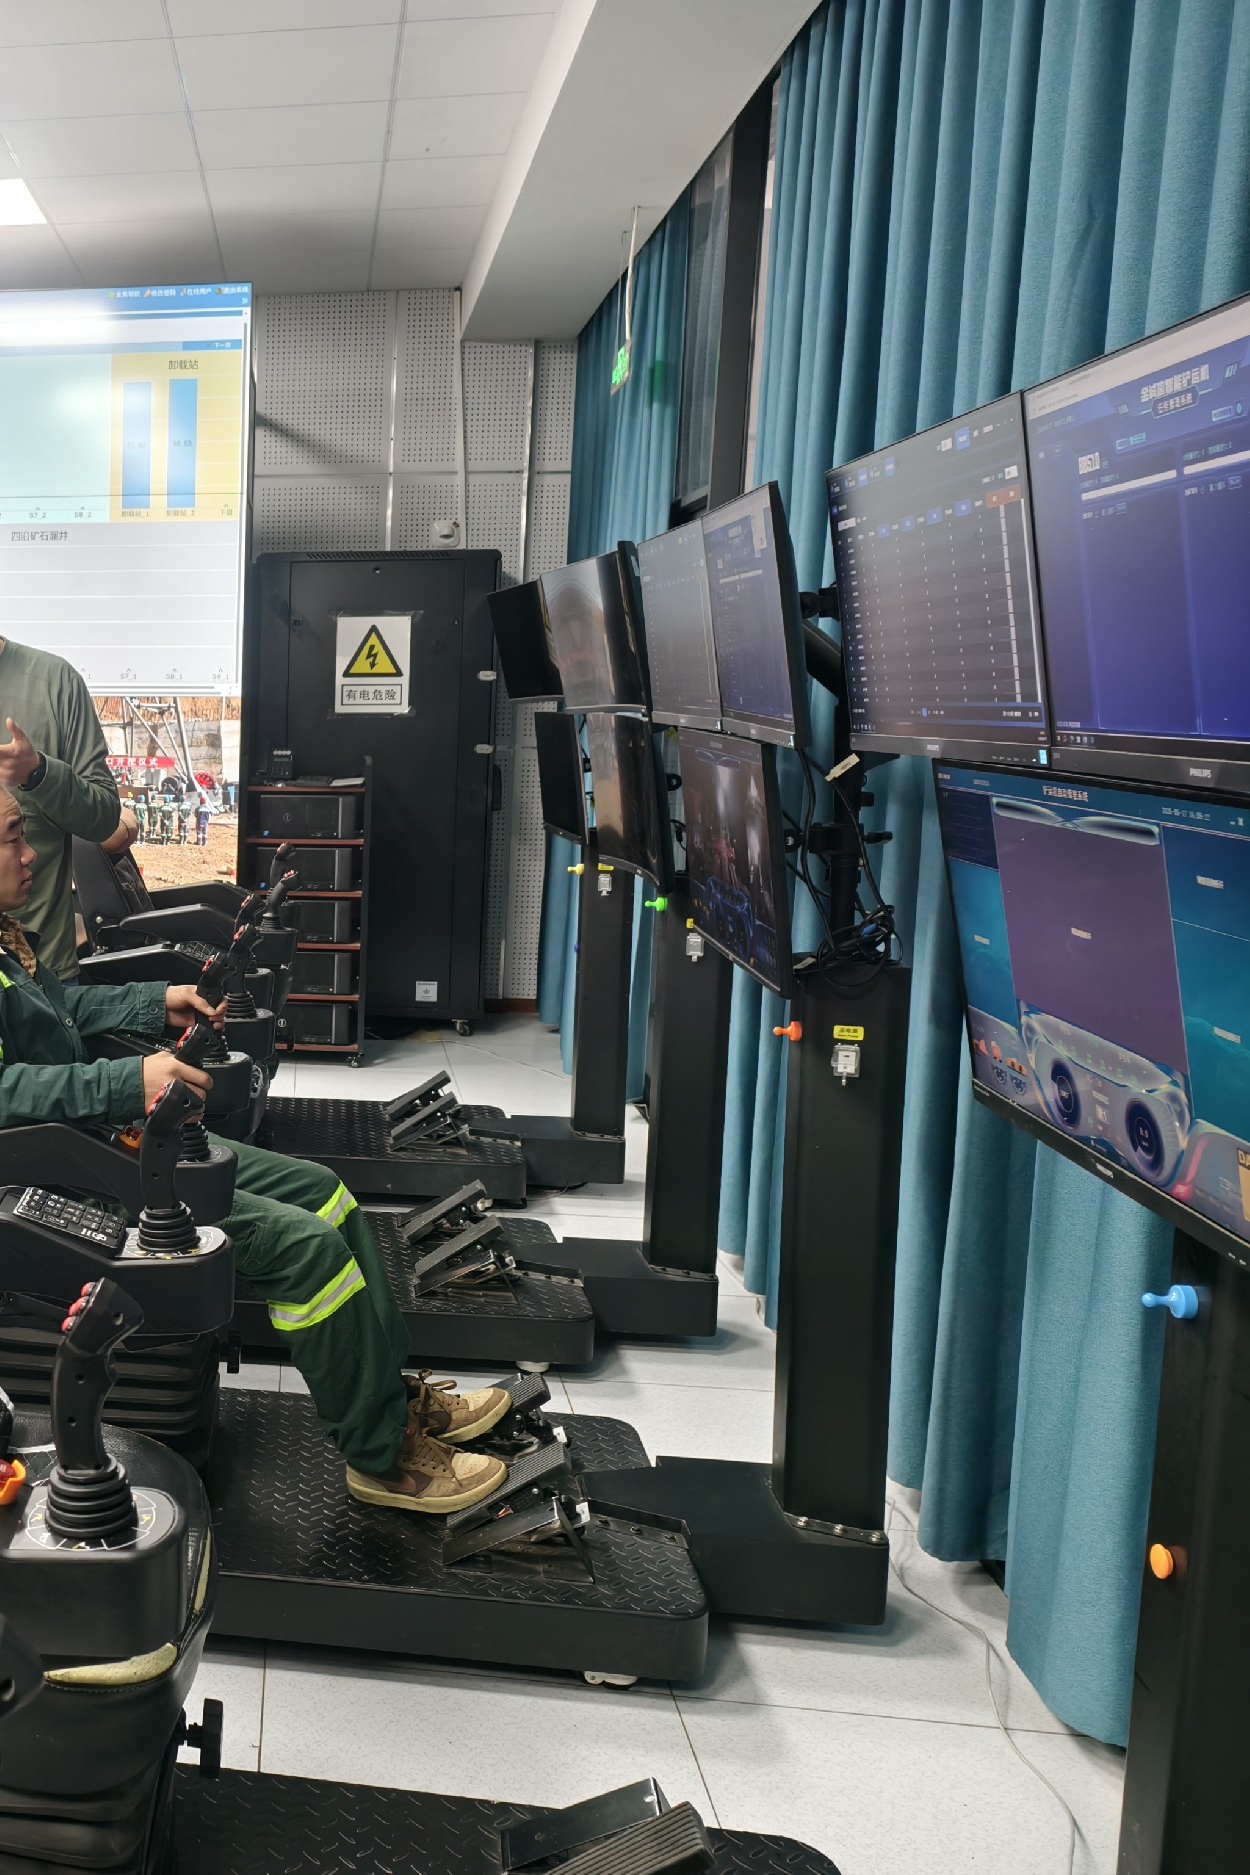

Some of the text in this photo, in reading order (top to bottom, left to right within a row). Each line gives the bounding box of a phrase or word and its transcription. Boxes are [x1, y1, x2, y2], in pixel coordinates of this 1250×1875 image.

[168, 360, 199, 370] 卸载站
[11, 530, 69, 542] 四沿矿石溜井
[345, 688, 397, 701] 有电危险
[1189, 767, 1212, 779] PHILIPS
